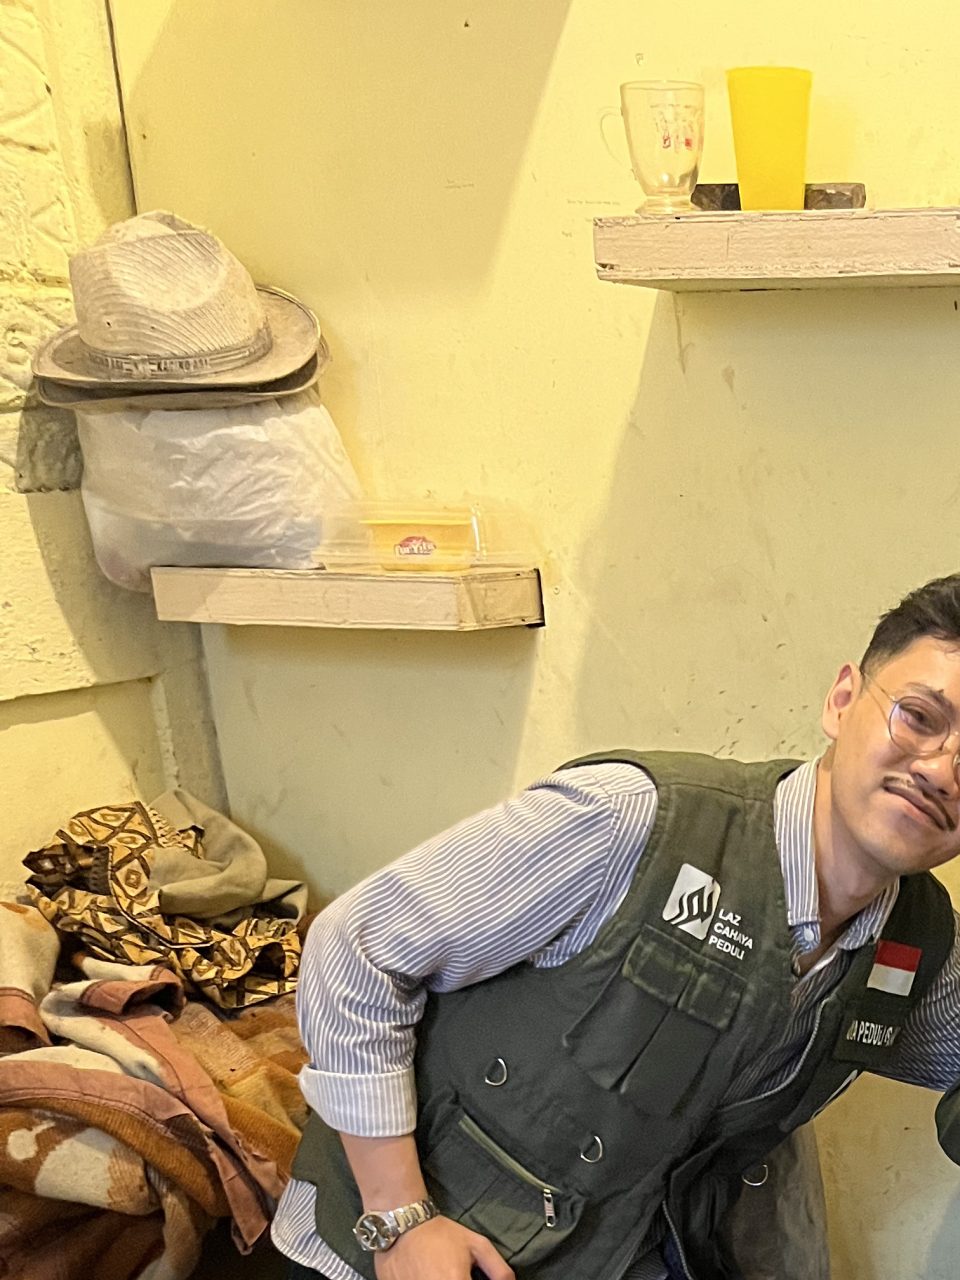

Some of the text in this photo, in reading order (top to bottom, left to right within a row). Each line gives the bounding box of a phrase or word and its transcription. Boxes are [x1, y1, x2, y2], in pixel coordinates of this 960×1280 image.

[717, 908, 742, 927] LAZ
[708, 935, 744, 960] PEDULI
[713, 924, 754, 950] CAHAYA
